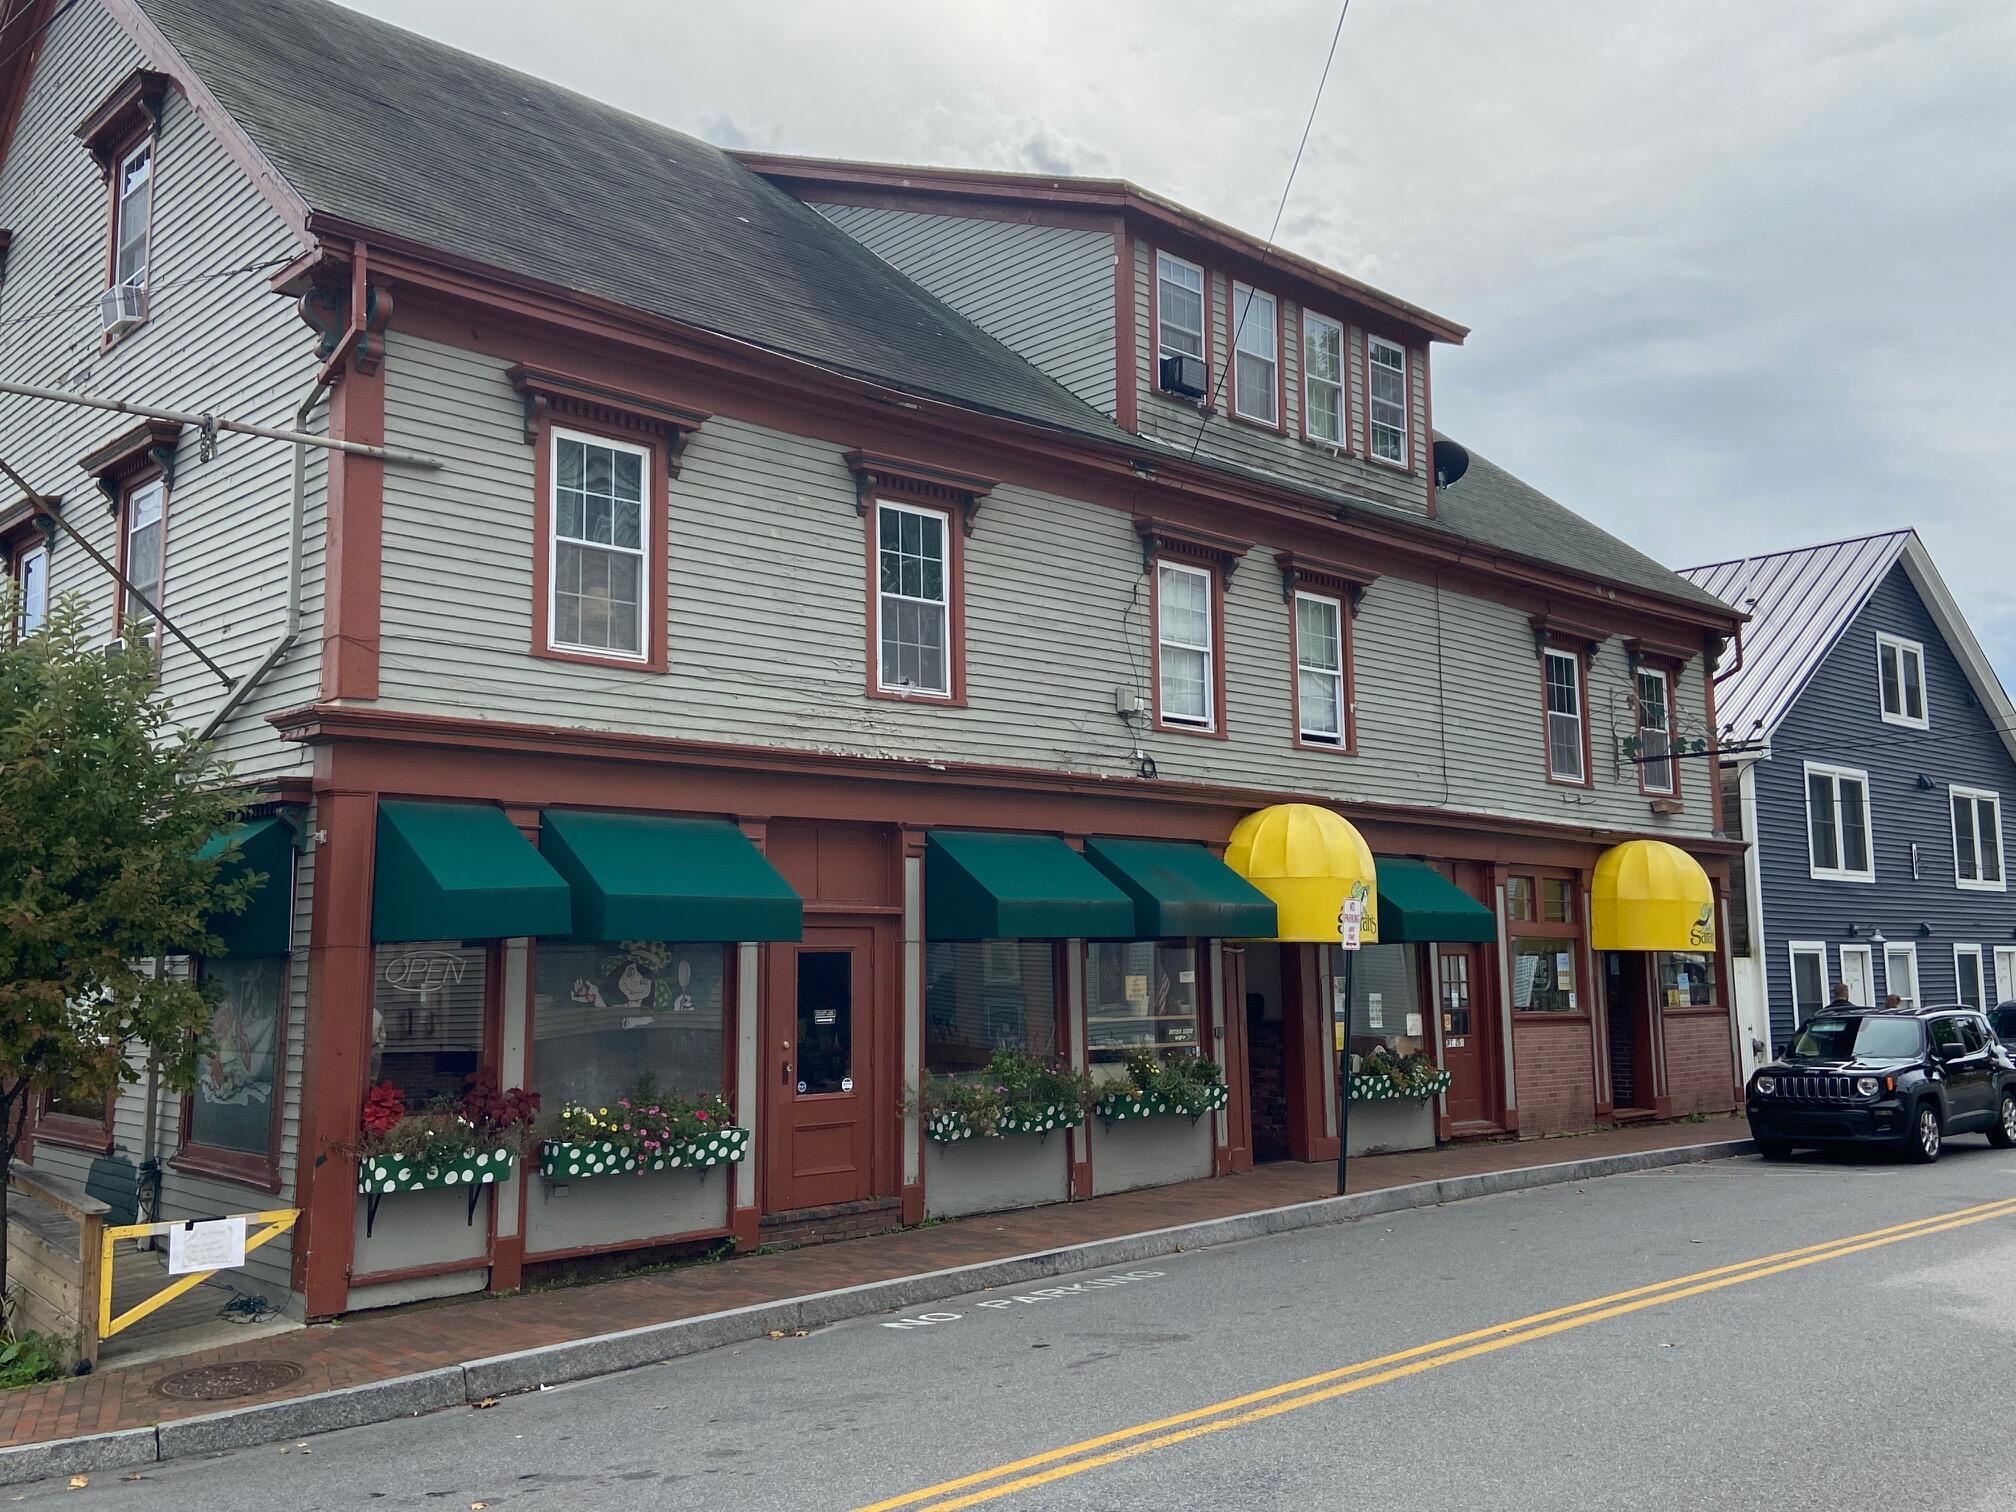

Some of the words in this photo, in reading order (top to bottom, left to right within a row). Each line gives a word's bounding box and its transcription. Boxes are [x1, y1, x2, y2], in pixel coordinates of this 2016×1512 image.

[386, 958, 467, 985] OPEN
[879, 1311, 963, 1330] NO
[975, 1270, 1166, 1310] PARKING
